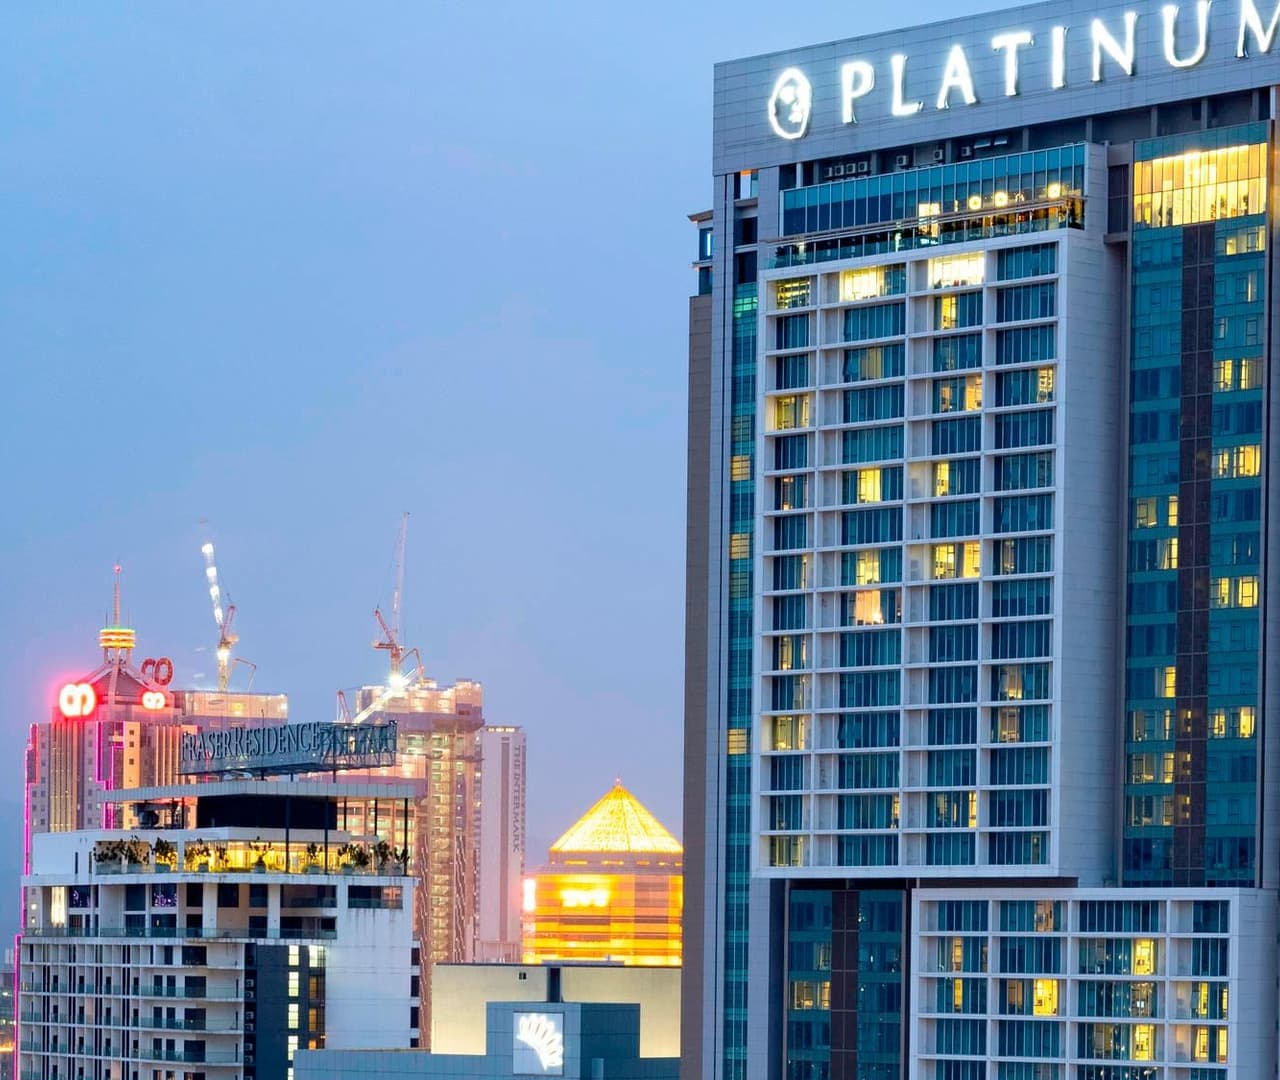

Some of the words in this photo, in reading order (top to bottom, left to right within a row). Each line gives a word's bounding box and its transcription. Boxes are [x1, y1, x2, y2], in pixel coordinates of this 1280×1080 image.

[181, 729, 233, 761] FRASER
[233, 721, 320, 758] RESIDENCE
[513, 745, 521, 769] THE
[513, 773, 521, 853] INTERMARK
